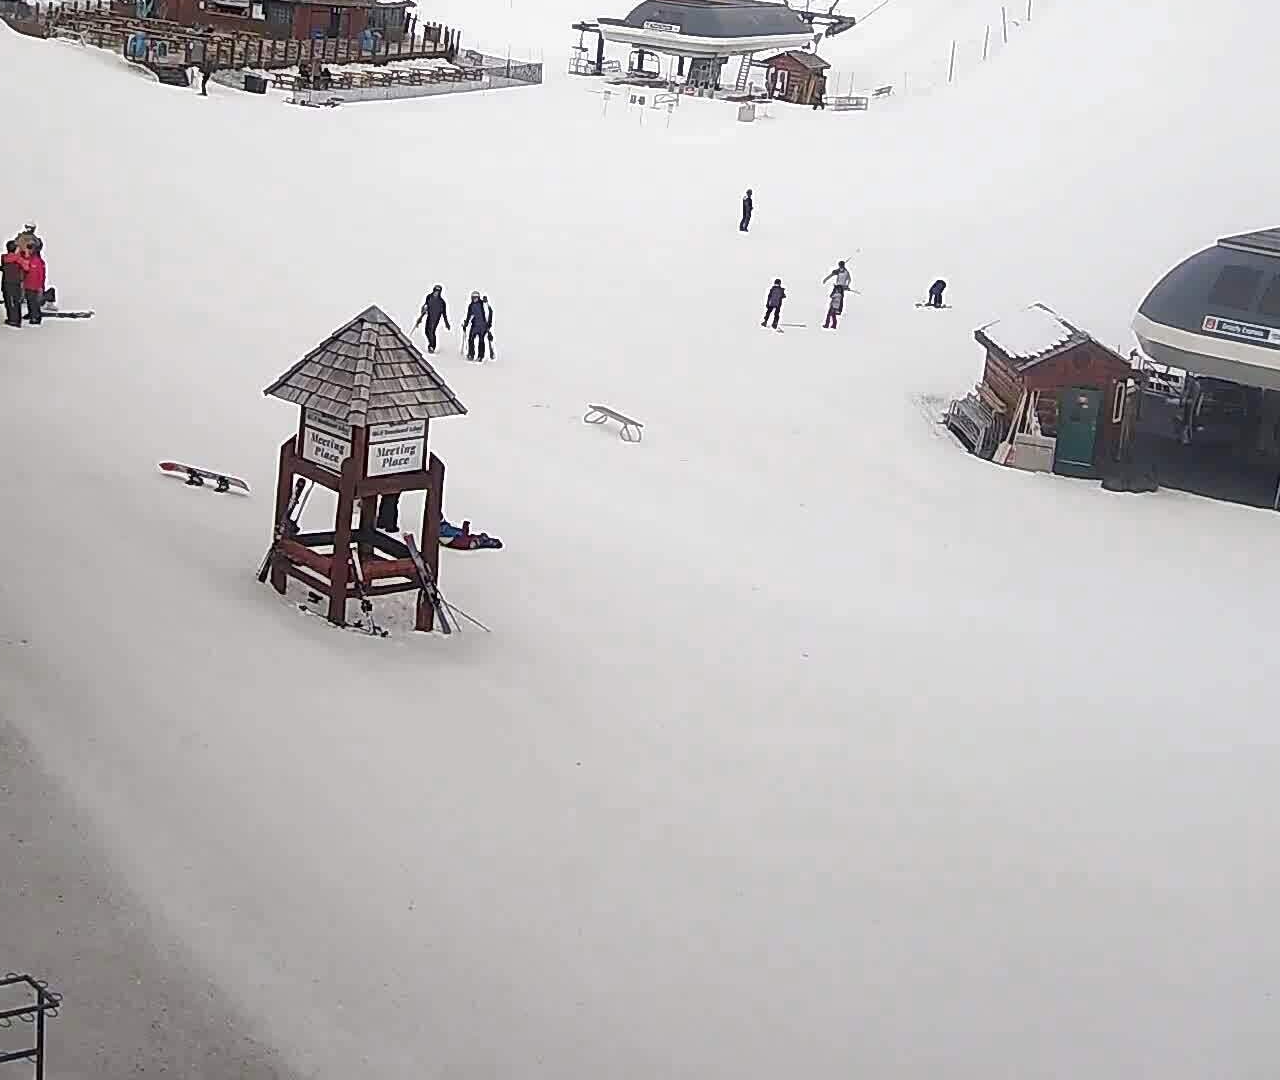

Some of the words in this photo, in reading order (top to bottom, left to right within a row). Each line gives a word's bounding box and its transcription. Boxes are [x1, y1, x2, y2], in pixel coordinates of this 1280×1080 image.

[311, 432, 345, 455] Meeting
[376, 444, 417, 458] Meeting
[315, 446, 340, 464] Place
[382, 456, 410, 468] Place
